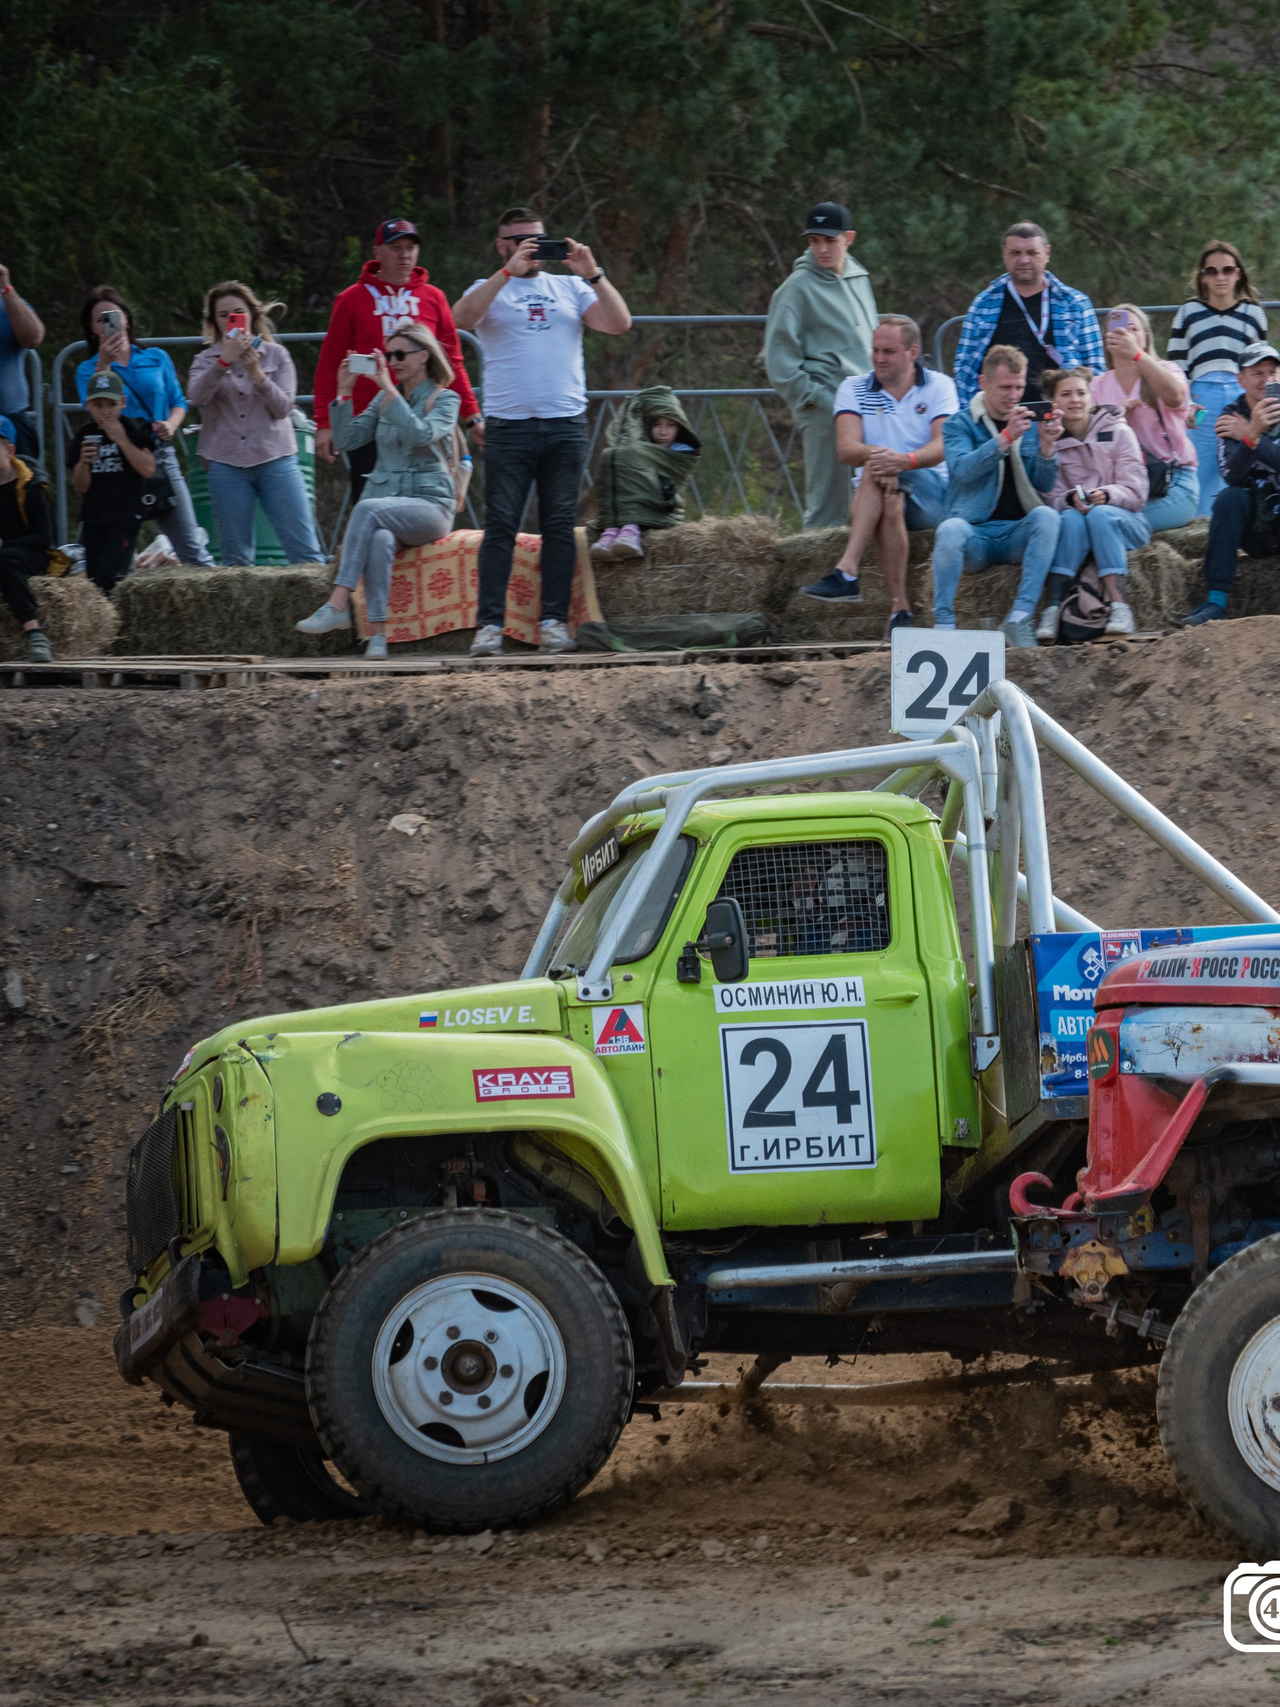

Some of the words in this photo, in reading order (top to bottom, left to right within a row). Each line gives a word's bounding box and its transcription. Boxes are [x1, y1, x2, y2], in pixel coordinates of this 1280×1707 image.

[373, 295, 420, 316] JUST
[905, 650, 990, 720] 24
[581, 837, 615, 887] ИРБИТ
[1139, 957, 1239, 979] РАЛЛИ-КРОСС
[720, 983, 815, 1008] ОСМИНИН
[444, 1007, 513, 1027] LOSEV
[518, 1006, 536, 1023] E.
[594, 1043, 646, 1055] АВТОЛАЙН
[608, 1036, 630, 1044] 136
[1061, 1052, 1088, 1065] Ирби
[477, 1071, 570, 1088] KRAYS
[739, 1033, 861, 1129] 24
[1074, 1069, 1088, 1079] 8-
[483, 1085, 567, 1096] GROUP
[739, 1134, 865, 1162] г.ИРБИТ
